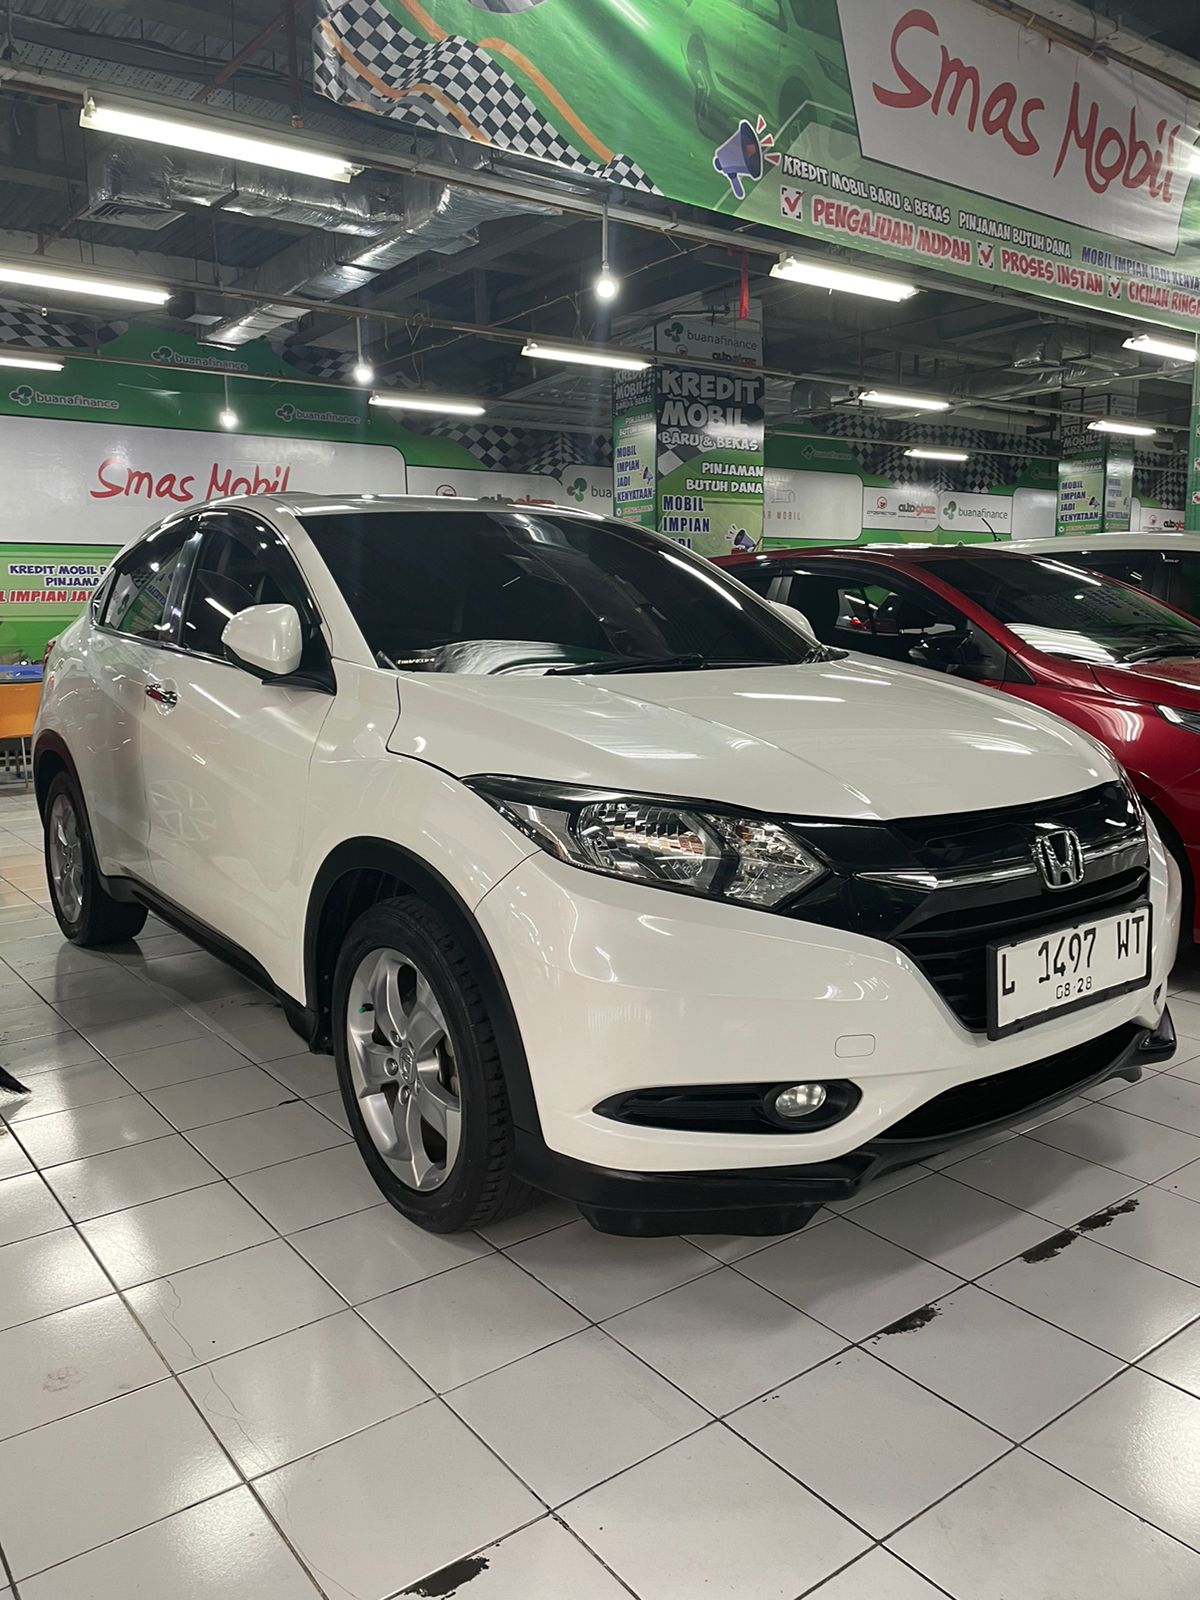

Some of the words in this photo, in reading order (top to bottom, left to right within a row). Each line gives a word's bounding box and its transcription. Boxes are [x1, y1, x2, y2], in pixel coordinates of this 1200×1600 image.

[872, 8, 1045, 156] Smas
[1053, 80, 1181, 203] Mobil
[783, 155, 828, 185] KREDIT
[831, 171, 868, 198] MOBIL
[869, 185, 901, 209] BARU
[902, 196, 913, 213] &
[914, 198, 951, 224] BEKAS
[813, 197, 914, 246] PENGAJUAN
[917, 228, 971, 263] MUDAH
[959, 210, 1011, 241] PINJAMAN
[1012, 226, 1045, 251] BUTUH
[1045, 235, 1072, 258] DANA
[1001, 249, 1054, 281] PROSES
[1056, 262, 1103, 293] INSTAN
[1081, 246, 1113, 269] MOBIL
[1114, 255, 1148, 278] IMPIAN
[1150, 266, 1170, 283] JADI
[1128, 280, 1170, 308] CICILAN
[687, 329, 758, 351] buanafinance
[173, 352, 249, 372] buanafinance
[661, 369, 760, 404] KREDIT
[34, 391, 119, 410] buanafinance
[660, 400, 748, 429] MOBIL
[661, 431, 700, 446] BARU
[702, 435, 714, 448] &
[715, 436, 759, 451] BEKAS
[616, 445, 637, 458] MOBIL
[616, 460, 640, 473] IMPIAN
[702, 462, 763, 477] PINJAMAN
[89, 455, 195, 502] Smas
[205, 462, 290, 502] Mobil
[616, 475, 631, 488] JADI
[686, 479, 728, 492] BUTUH
[731, 481, 764, 494] DANA
[1061, 481, 1083, 490] MOBIL
[616, 488, 653, 502] KENYATAAN
[663, 495, 704, 512] MOBIL
[776, 511, 801, 520] MOBIL
[958, 507, 1009, 520] buanafinance
[663, 517, 710, 532] IMPIAN
[9, 565, 55, 574] KREDIT
[58, 565, 97, 575] MOBIL
[9, 590, 67, 602] IMPIAN
[1002, 953, 1015, 997] L
[1037, 926, 1097, 984] 1497
[1116, 914, 1145, 960] WT
